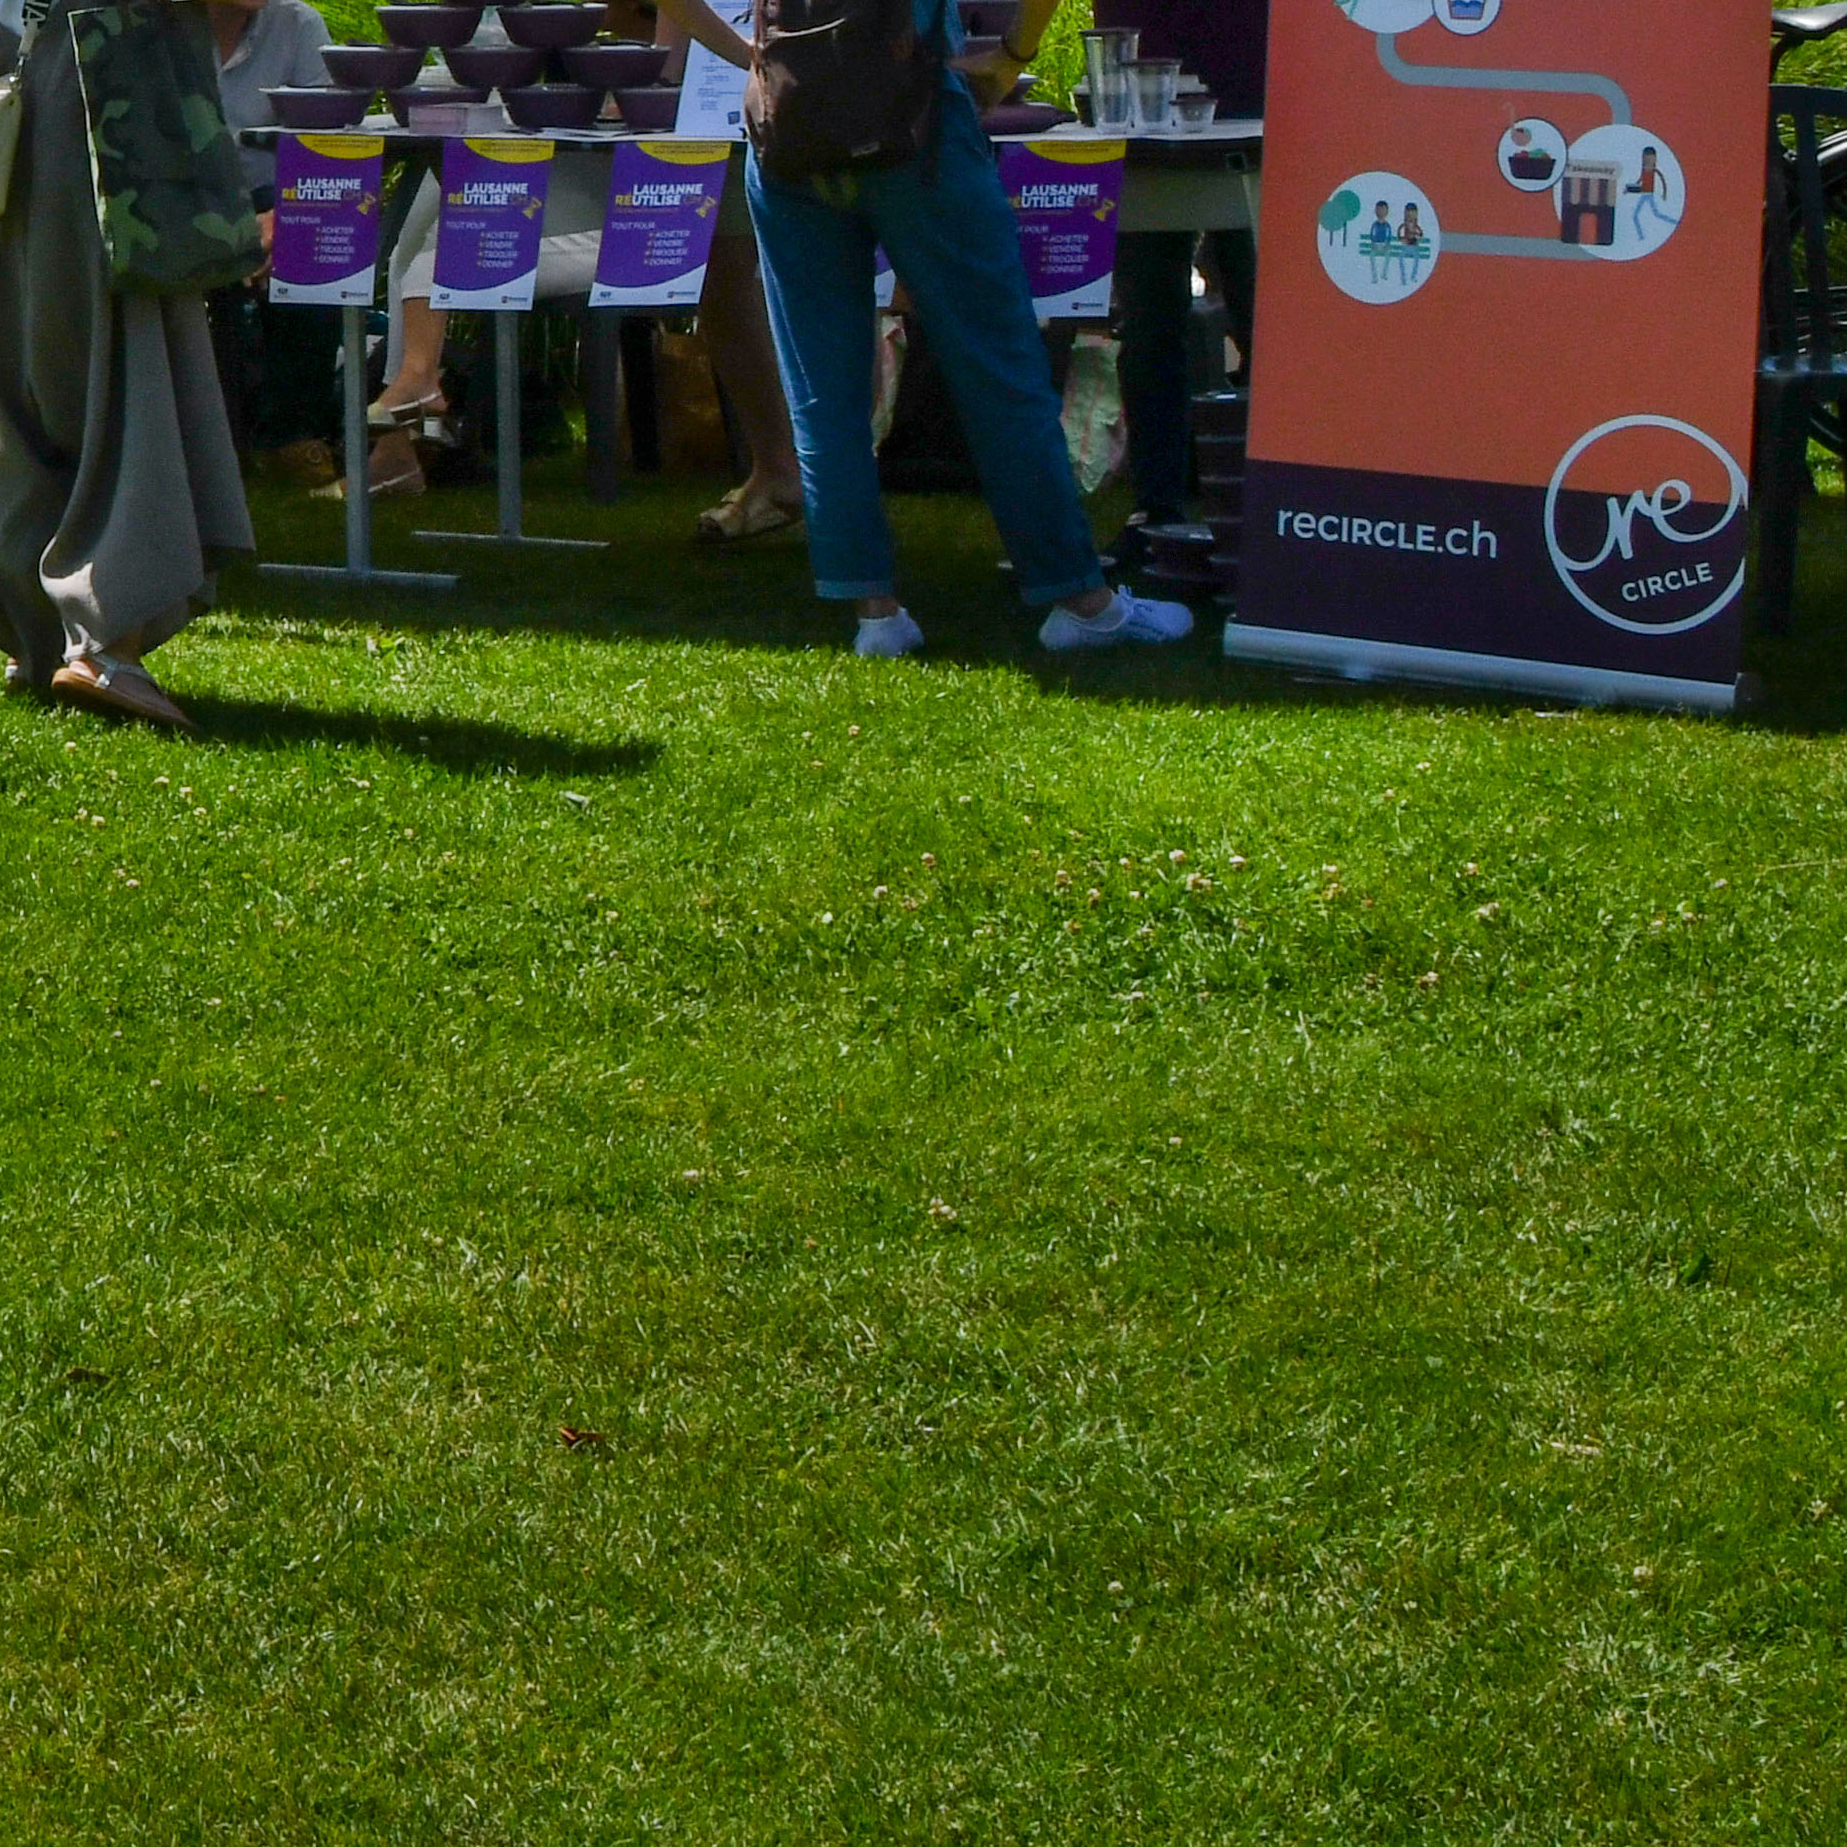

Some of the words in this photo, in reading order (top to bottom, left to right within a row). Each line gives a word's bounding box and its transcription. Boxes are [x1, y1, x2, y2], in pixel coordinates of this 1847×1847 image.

[297, 177, 363, 190] LAUSANNE
[464, 182, 528, 195] LAUSANNE
[633, 183, 703, 195] LAUSANNE
[1021, 184, 1098, 196] LAUSANNE
[1276, 505, 1497, 558] reCIRCLE.ch
[1621, 562, 1713, 603] CIRCLE
